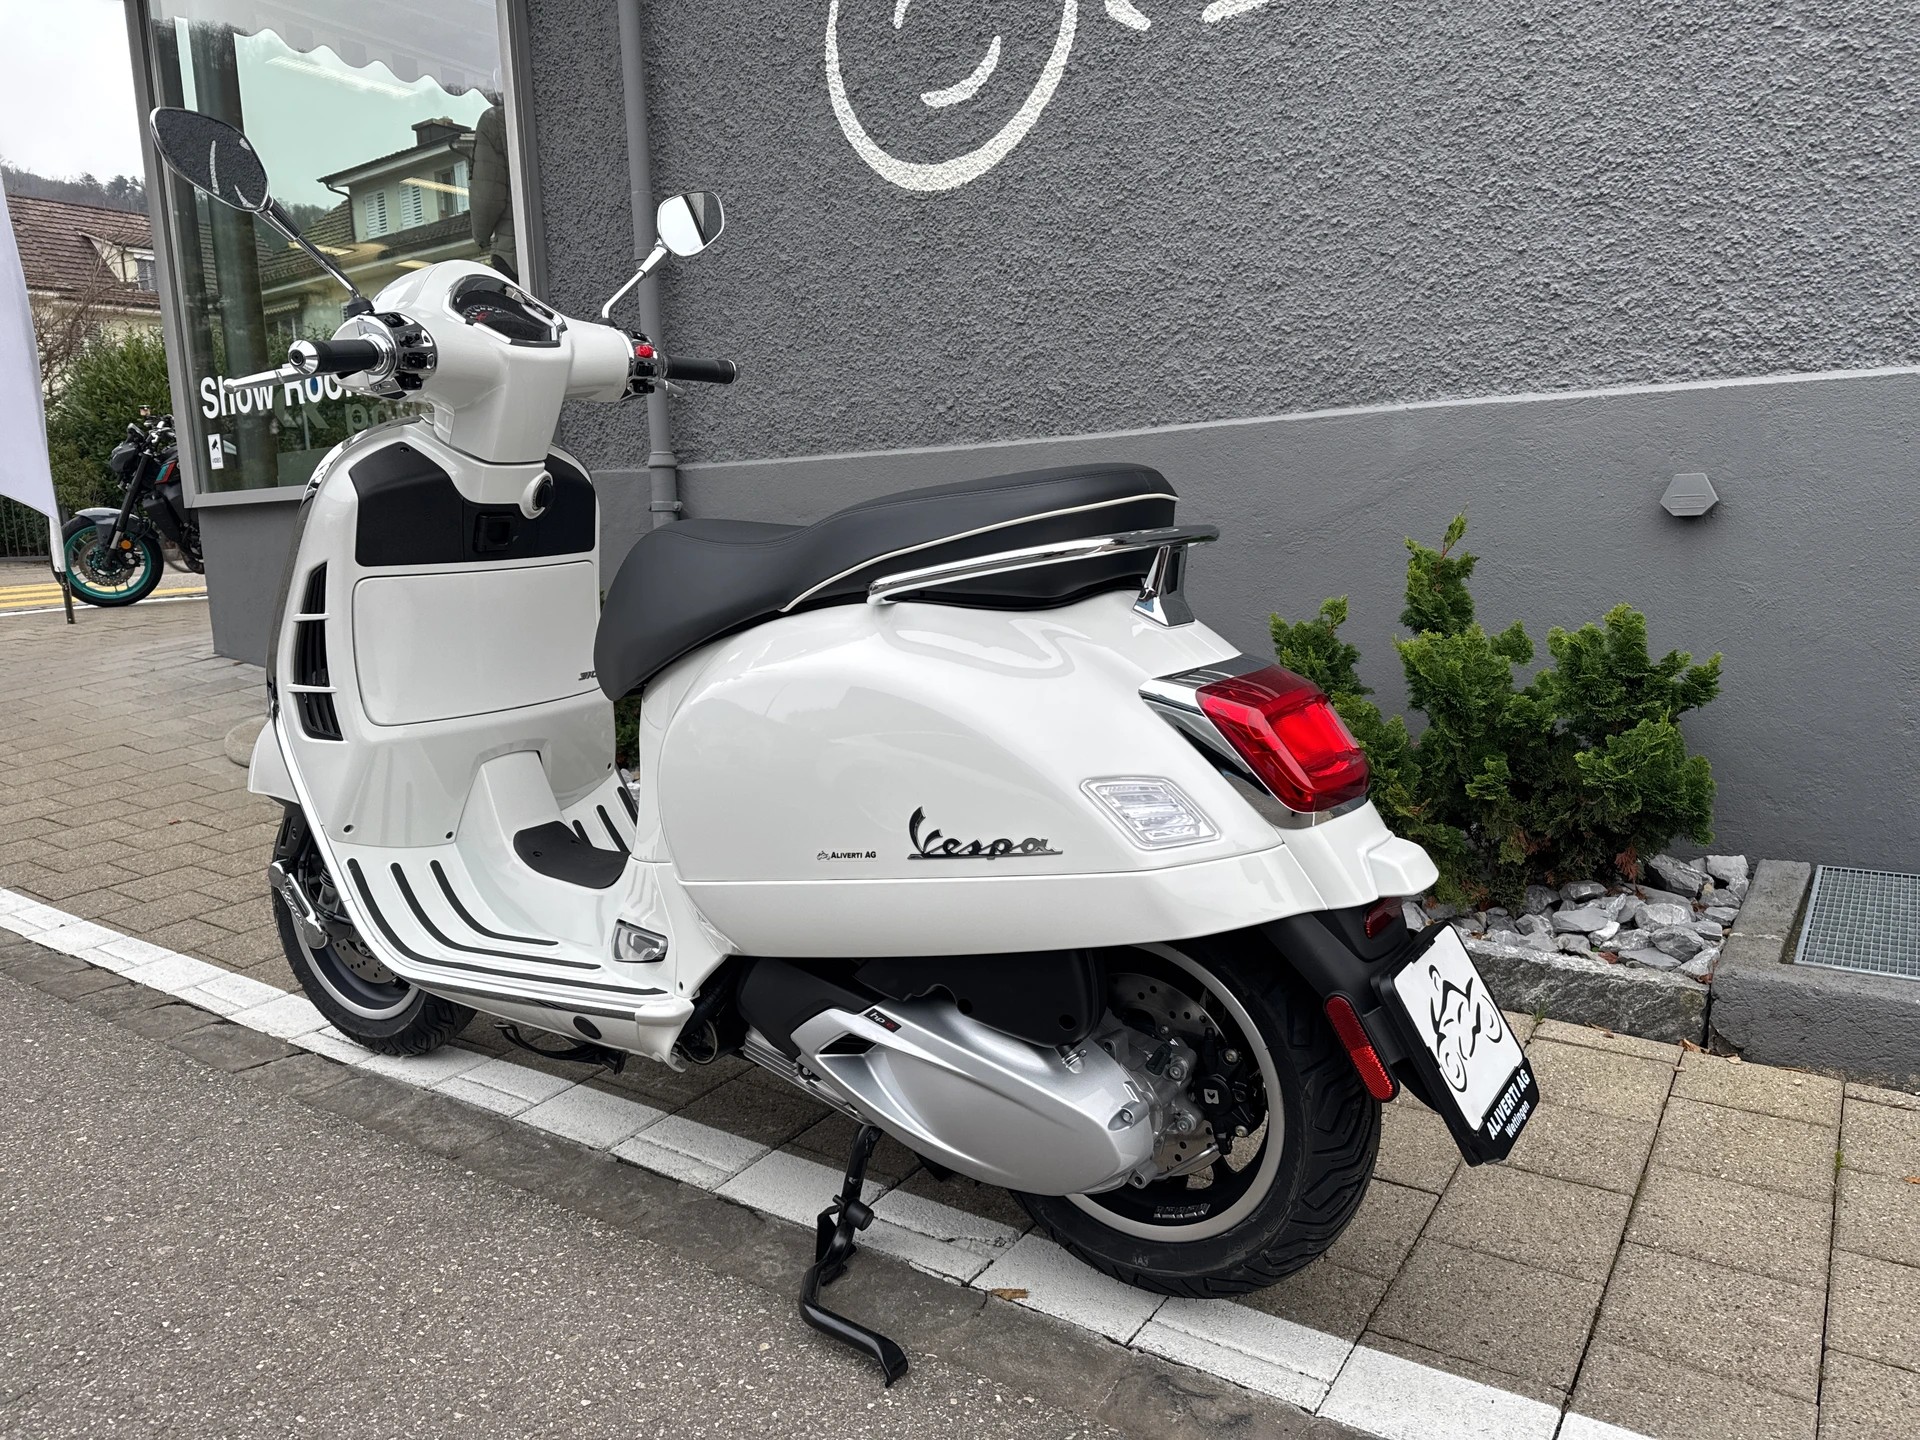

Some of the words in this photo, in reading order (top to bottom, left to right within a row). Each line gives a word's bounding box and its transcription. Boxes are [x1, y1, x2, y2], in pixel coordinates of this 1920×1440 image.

[200, 375, 273, 419] Show
[284, 374, 361, 407] Roo
[830, 851, 863, 859] ALIVERTI
[864, 850, 877, 859] AG
[907, 805, 1064, 860] Vespa
[1486, 1082, 1522, 1141] ALIVERTI
[1515, 1068, 1531, 1093] AG
[1504, 1100, 1531, 1139] Wettingen
